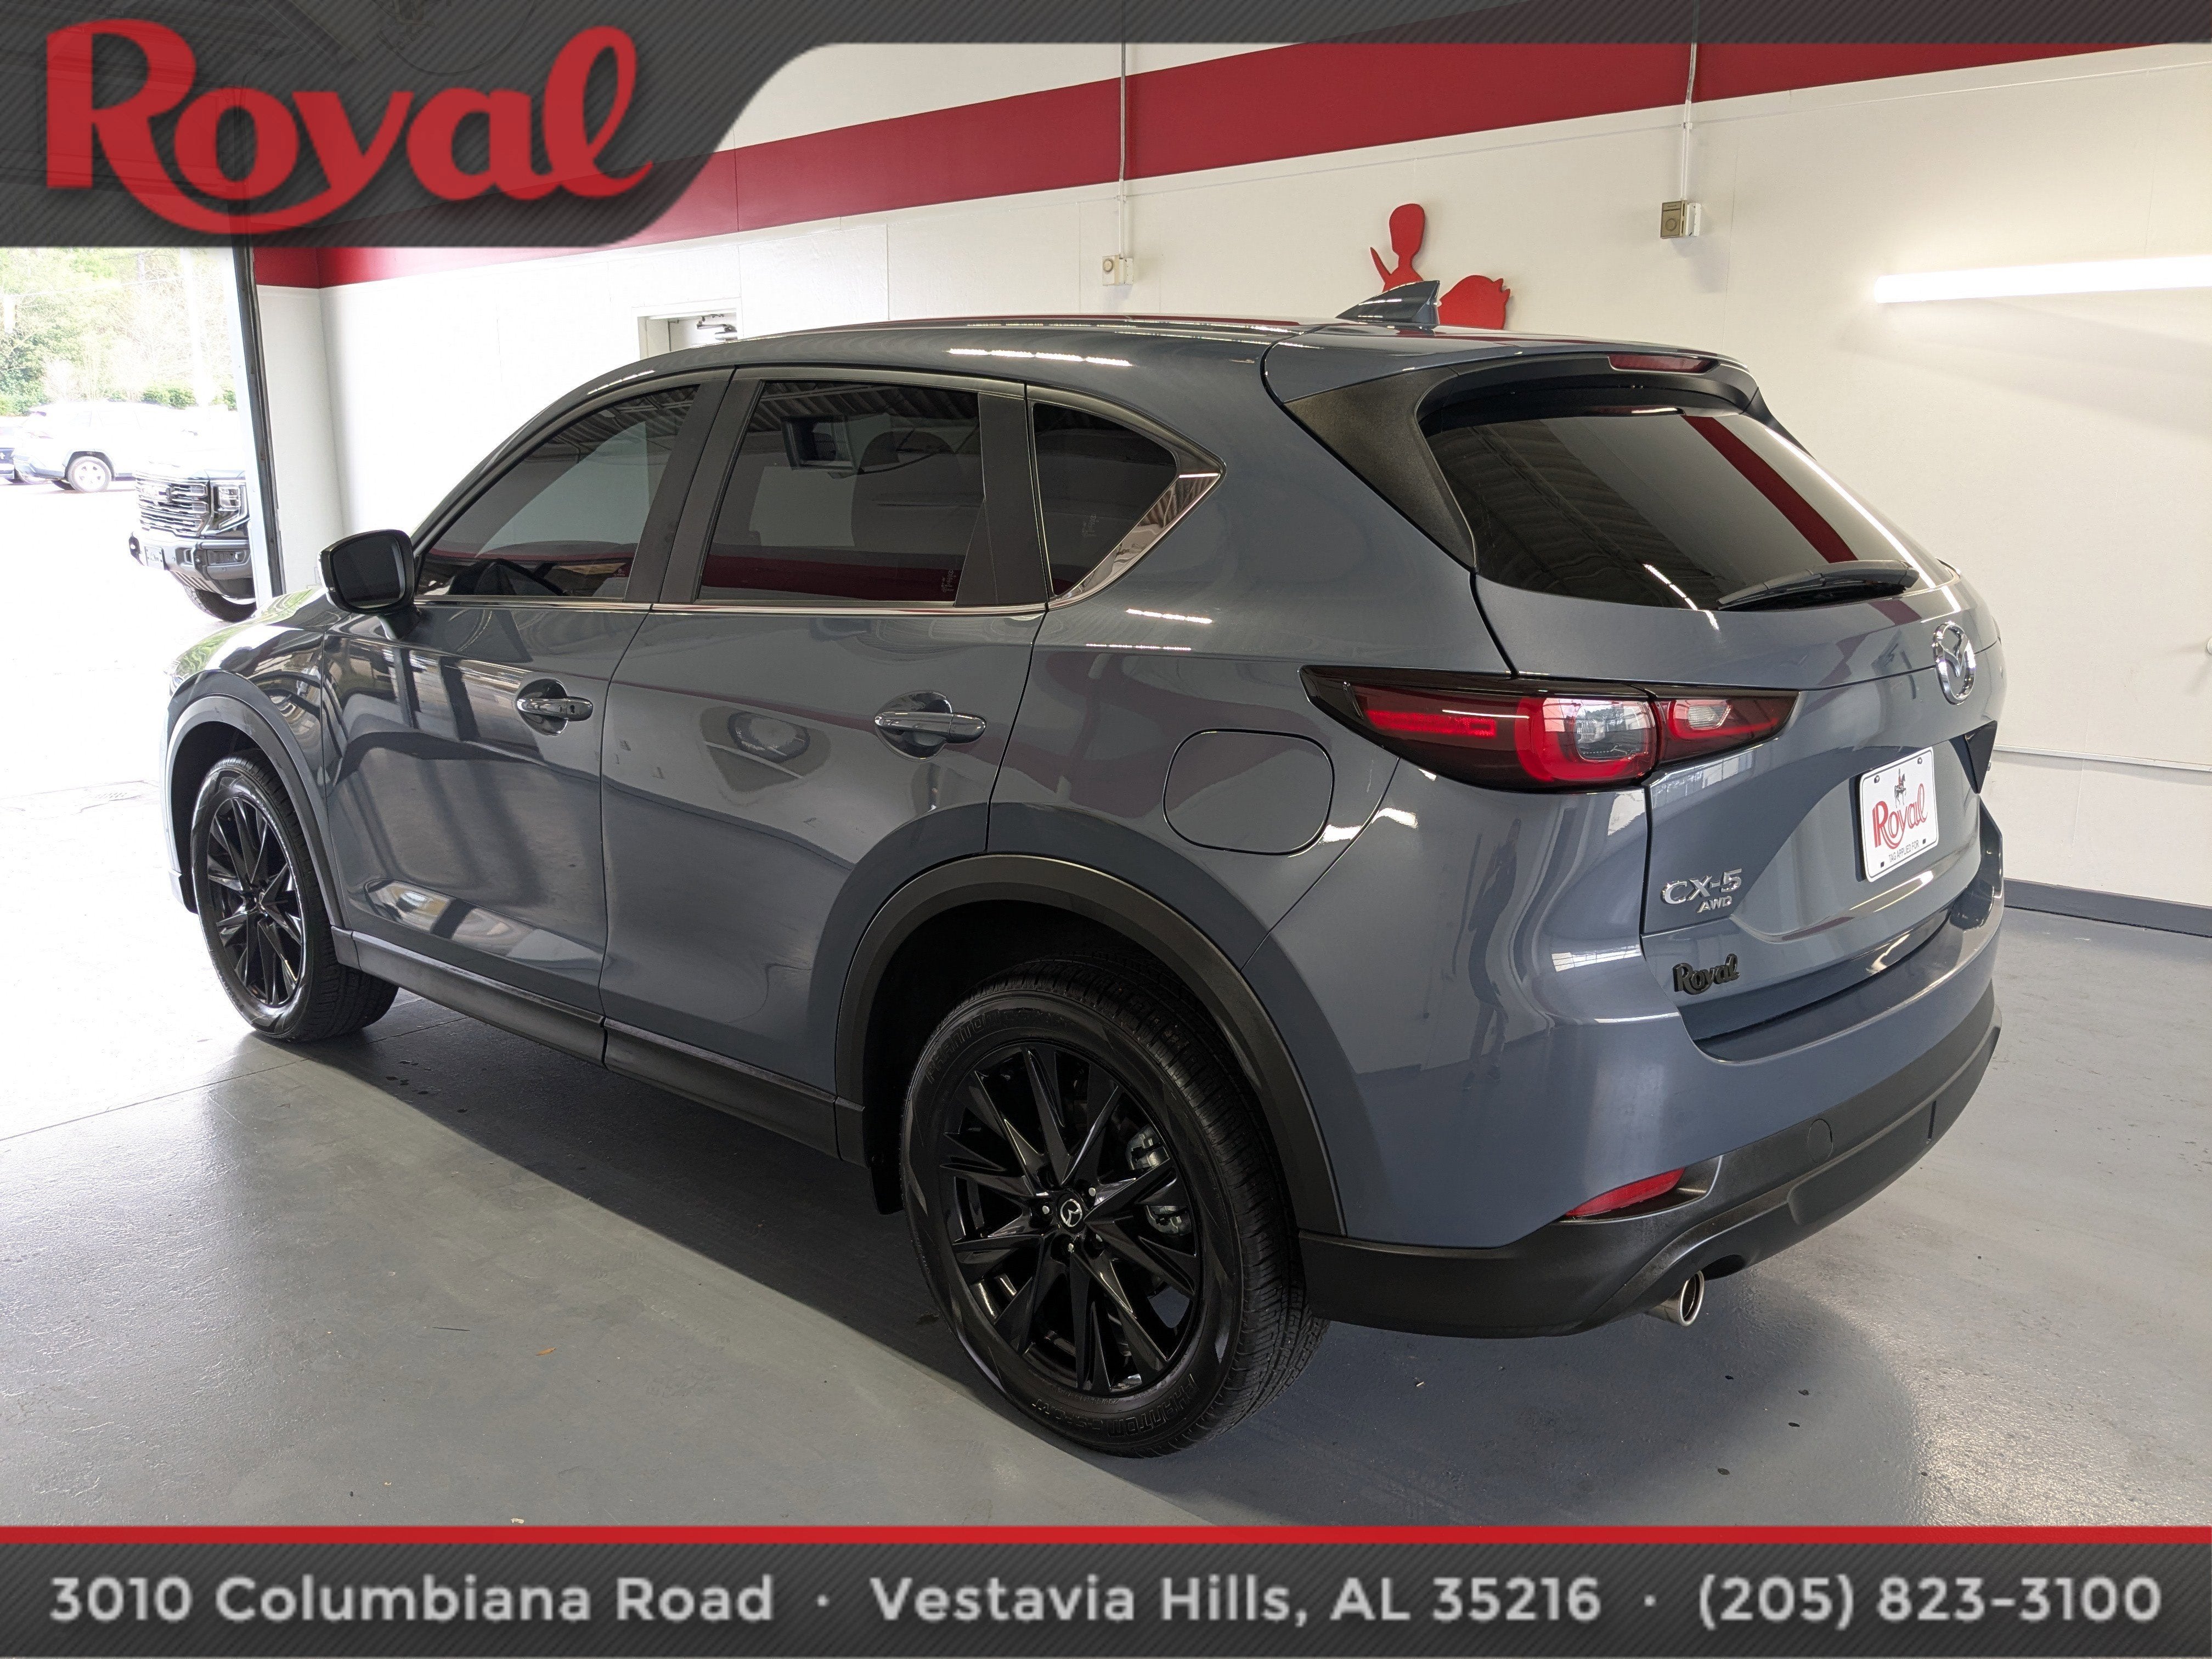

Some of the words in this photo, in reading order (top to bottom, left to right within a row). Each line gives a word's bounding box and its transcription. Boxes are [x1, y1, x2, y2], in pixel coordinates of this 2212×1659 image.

[1872, 783, 1928, 849] Royal
[1888, 851, 1897, 862] TAG
[1897, 844, 1911, 859] APPLIED
[1911, 839, 1920, 850] FOR
[1660, 868, 1742, 904] CX-5
[1696, 895, 1733, 913] AWD
[1672, 953, 1740, 995] Royal
